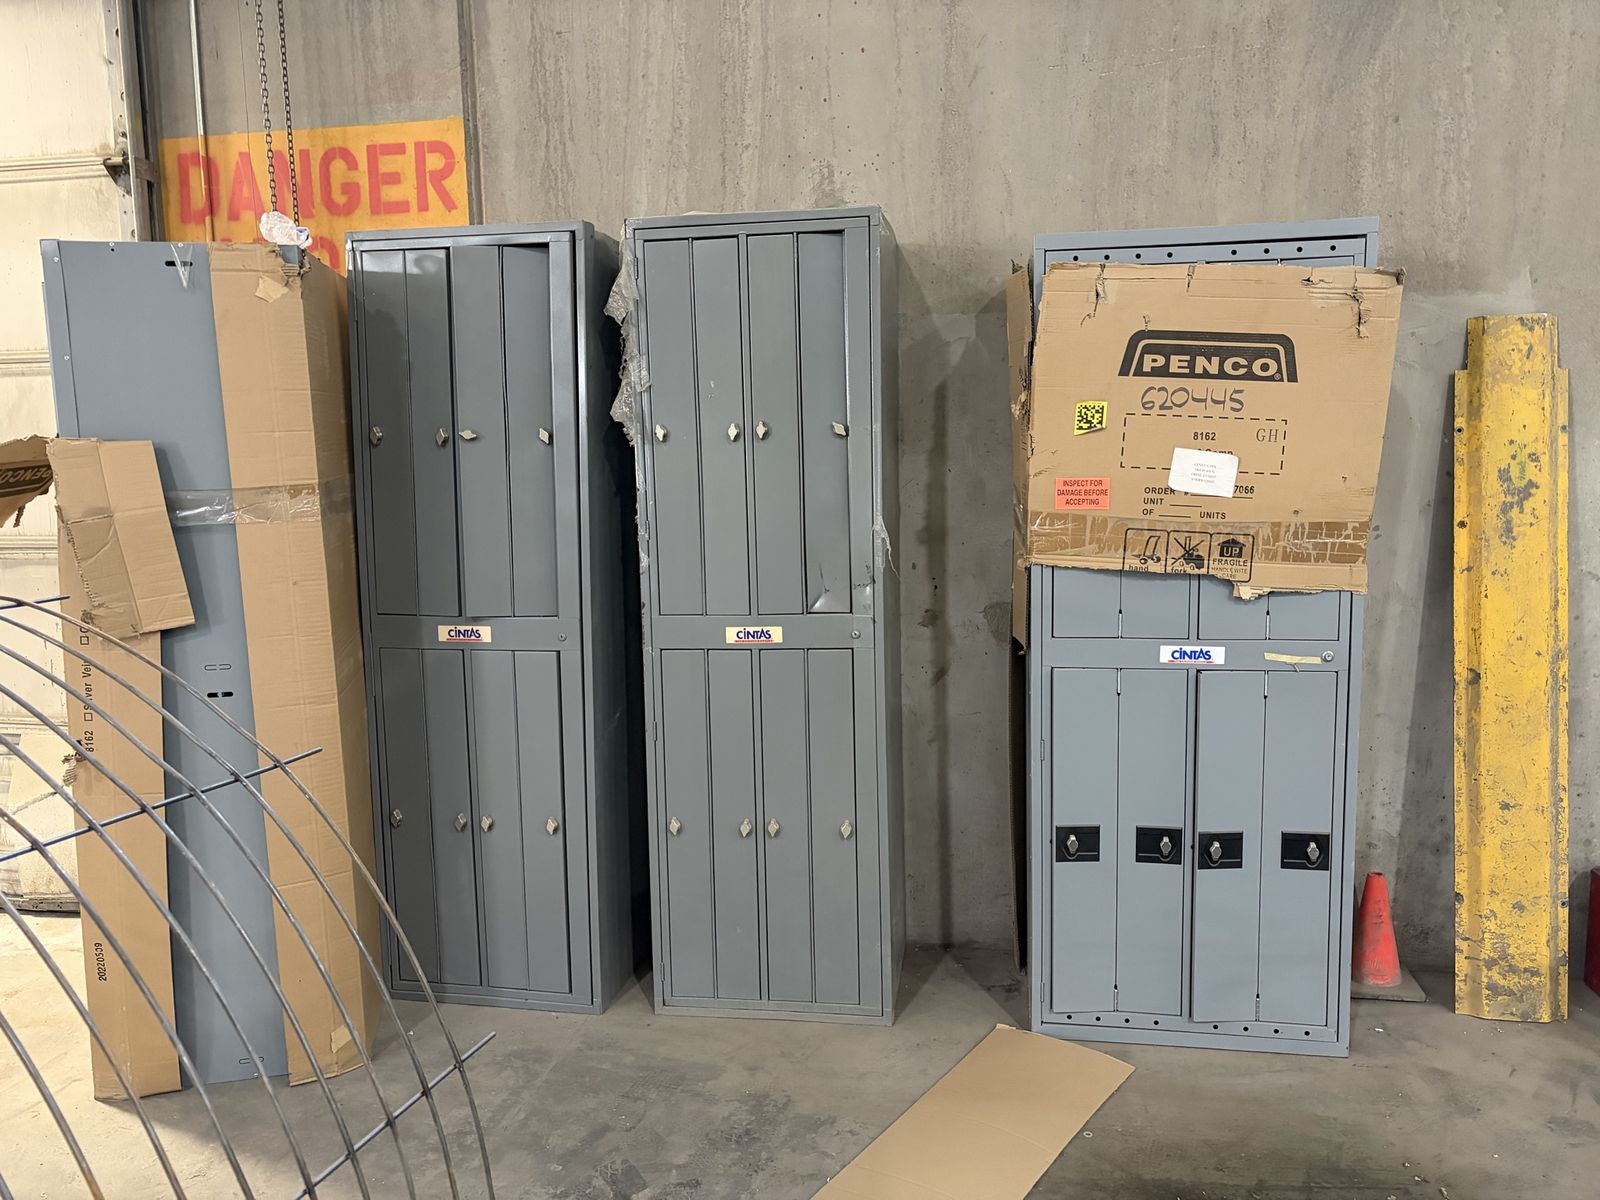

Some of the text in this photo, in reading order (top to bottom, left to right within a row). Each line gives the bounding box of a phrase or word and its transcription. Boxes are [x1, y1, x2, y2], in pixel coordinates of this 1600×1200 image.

[177, 140, 458, 224] DANGER
[1142, 354, 1279, 377] PENCO
[1141, 386, 1245, 412] 620445
[1193, 431, 1217, 441] 8162
[1256, 428, 1279, 443] GH
[1063, 479, 1089, 487] INSPECT
[1057, 489, 1083, 497] DAMAGE
[1144, 486, 1176, 495] ORDER
[1065, 498, 1099, 506] ACCEPTING
[1143, 497, 1164, 505] UNIT
[1142, 508, 1227, 520] OF UNITS
[1224, 547, 1240, 557] UP
[1212, 558, 1248, 567] FRAGILE
[81, 659, 92, 679] Vei
[84, 730, 95, 753] 8162
